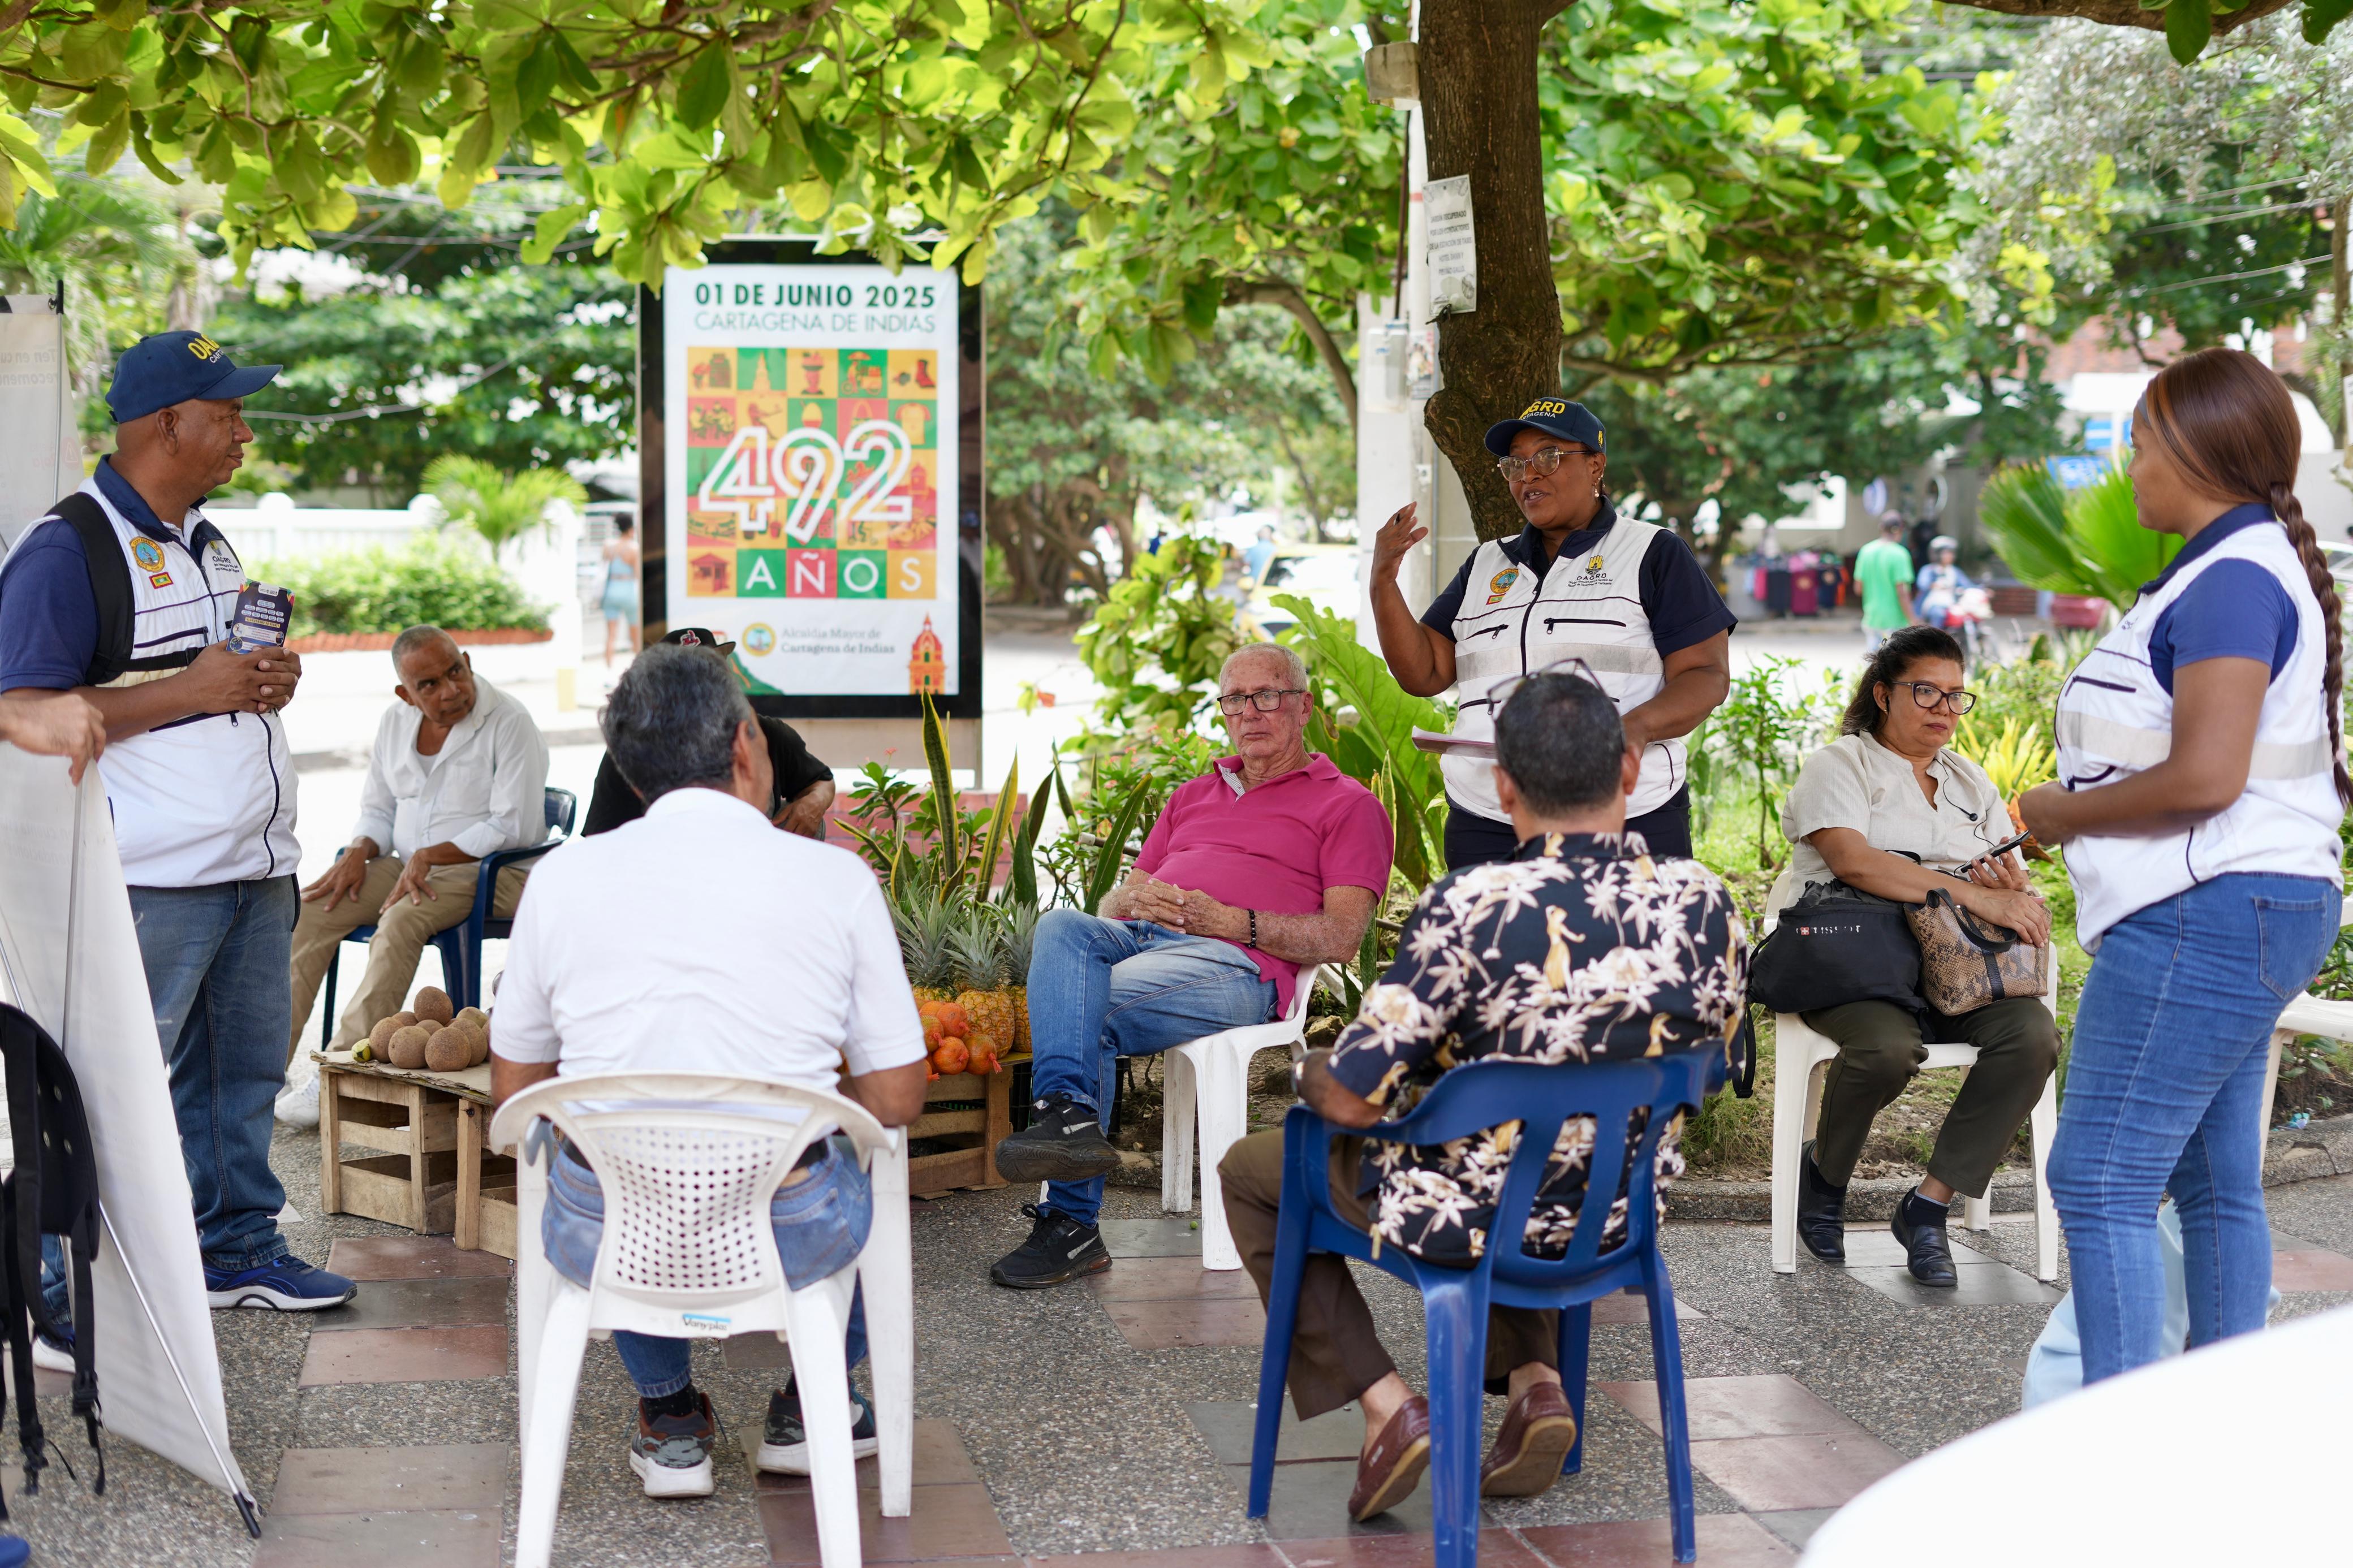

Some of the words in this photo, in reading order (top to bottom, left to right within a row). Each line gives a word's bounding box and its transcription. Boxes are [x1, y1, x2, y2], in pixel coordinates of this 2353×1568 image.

[696, 283, 722, 305] 01
[735, 284, 764, 306] DE
[774, 284, 853, 306] JUNIO
[866, 286, 934, 308] 2025
[695, 312, 825, 332] CARTAGENA
[832, 314, 858, 332] DE
[865, 314, 936, 334] INDIAS
[699, 419, 912, 545] 492
[745, 551, 922, 594] AÑOS
[830, 628, 866, 640] Mayor
[868, 628, 881, 639] de
[782, 642, 841, 655] Cartagena
[847, 643, 856, 654] de
[859, 643, 895, 654] Indias
